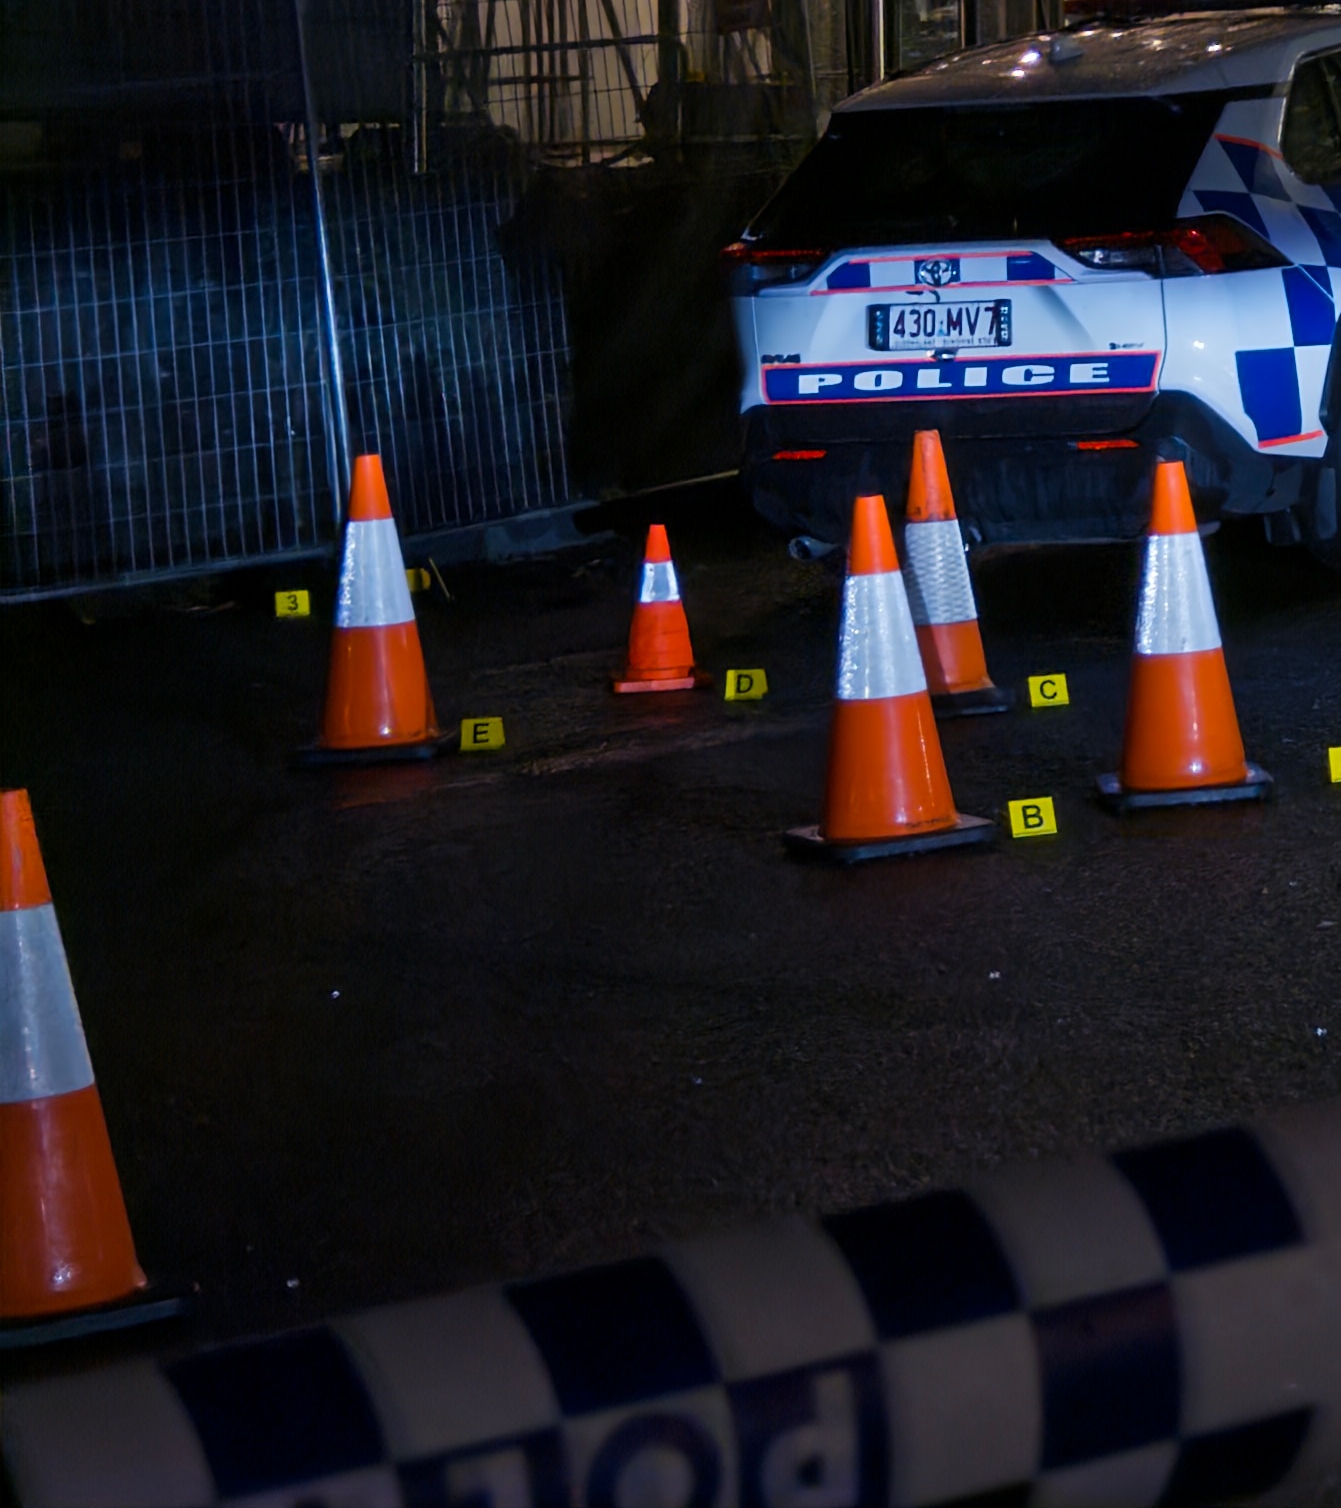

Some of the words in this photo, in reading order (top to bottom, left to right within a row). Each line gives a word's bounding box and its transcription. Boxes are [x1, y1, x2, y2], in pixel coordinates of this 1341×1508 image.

[797, 362, 1111, 394] POLICE
[737, 673, 754, 695] D
[1038, 679, 1059, 701] C
[472, 723, 490, 744] E
[1022, 803, 1045, 830] B
